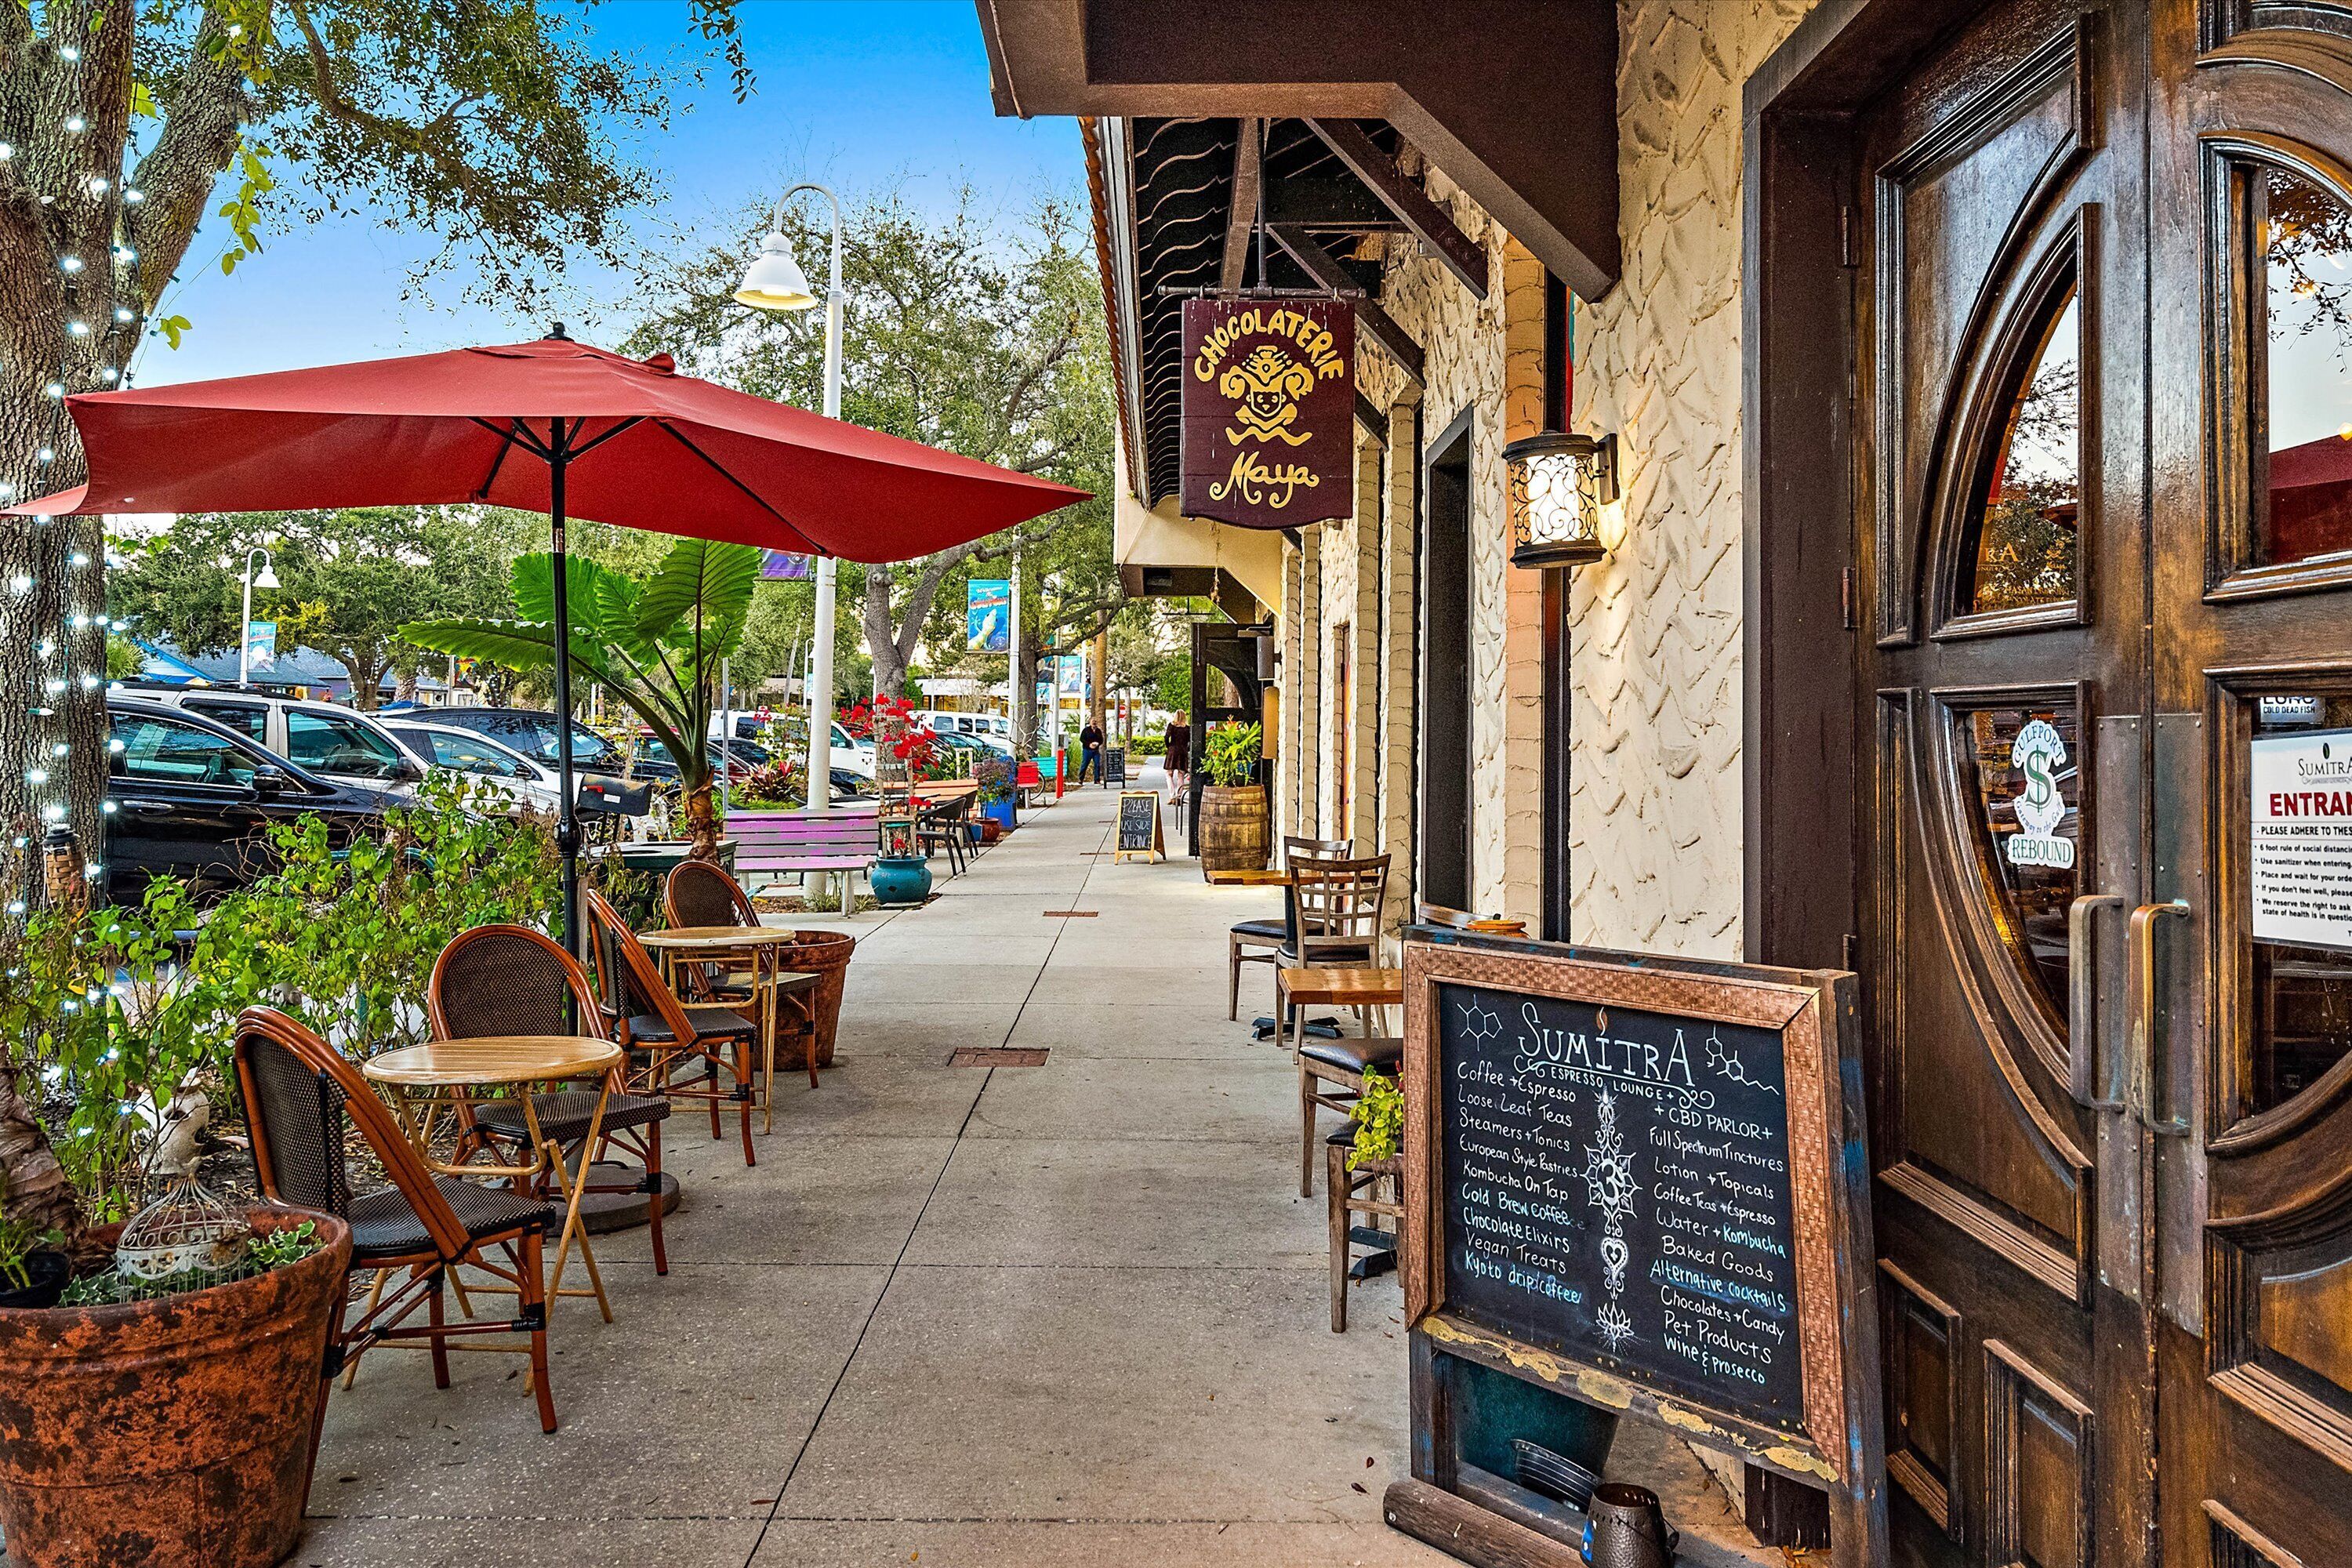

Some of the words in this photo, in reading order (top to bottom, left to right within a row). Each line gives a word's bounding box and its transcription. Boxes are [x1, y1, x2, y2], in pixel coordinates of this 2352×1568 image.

[1194, 308, 1345, 382] CHOCOLATERIE
[1209, 451, 1319, 509] Maya
[2014, 724, 2064, 764] GULFPORT
[1121, 819, 1132, 831] USE
[1134, 819, 1151, 831] SIDE
[1123, 798, 1151, 813] PLEASE
[1120, 833, 1152, 849] ENTRANCE
[2012, 838, 2071, 863] REBOUND
[2261, 826, 2288, 835] PLEASE
[2290, 826, 2318, 836] ADHERE
[2321, 826, 2331, 836] TO
[2313, 887, 2329, 897] well,
[2331, 888, 2352, 897] please
[2321, 874, 2335, 883] your
[2288, 909, 2310, 918] health
[2319, 911, 2325, 920] in
[2312, 902, 2328, 911] right
[1518, 1002, 1695, 1087] SUMITRA
[1457, 1060, 1504, 1087] Coffee
[1518, 1074, 1576, 1103] Espresso
[1551, 1067, 1603, 1088] ESPRESSO
[1613, 1080, 1663, 1101] LOUNGE
[1458, 1084, 1493, 1108] Loose
[1500, 1093, 1532, 1117] Leaf
[1538, 1103, 1573, 1127] Teas
[1668, 1107, 1702, 1127] CBD
[1706, 1114, 1762, 1139] PARLOR
[1460, 1106, 1523, 1141] Steamers
[1531, 1125, 1570, 1152] Tonics
[1650, 1126, 1671, 1149] Full
[1672, 1130, 1722, 1160] Spectrum
[1722, 1142, 1784, 1172] Tinctures
[1460, 1133, 1509, 1162] European
[1512, 1147, 1537, 1172] Style
[1539, 1152, 1577, 1178] Pastries
[1463, 1159, 1522, 1189] Kombucha
[1525, 1175, 1540, 1194] On
[1543, 1178, 1568, 1204] Tap
[1654, 1156, 1699, 1181] Lotion
[1716, 1171, 1774, 1200] Topicals
[1462, 1182, 1490, 1207] Cold
[1498, 1191, 1529, 1216] Brew
[1531, 1203, 1571, 1225] Coffee
[1654, 1182, 1692, 1206] Coffee
[1692, 1191, 1717, 1213] Teas
[1726, 1200, 1776, 1225] Espresso
[1464, 1207, 1523, 1240] Chocolate
[1526, 1225, 1570, 1254] Elixirs
[1465, 1227, 1509, 1259] Vegan
[1516, 1243, 1566, 1274] Treats
[1656, 1207, 1708, 1237] Water
[1722, 1221, 1787, 1259] Kombucha
[1465, 1250, 1501, 1279] Kyoto
[1650, 1259, 1722, 1293] Alternative
[1661, 1235, 1715, 1265] Baked
[1722, 1251, 1773, 1283] Goods
[1661, 1284, 1731, 1321] Chocolates
[1741, 1308, 1784, 1345] Candy
[1664, 1310, 1691, 1337] Pet
[1697, 1319, 1772, 1364] Products
[1664, 1333, 1699, 1362] Wine
